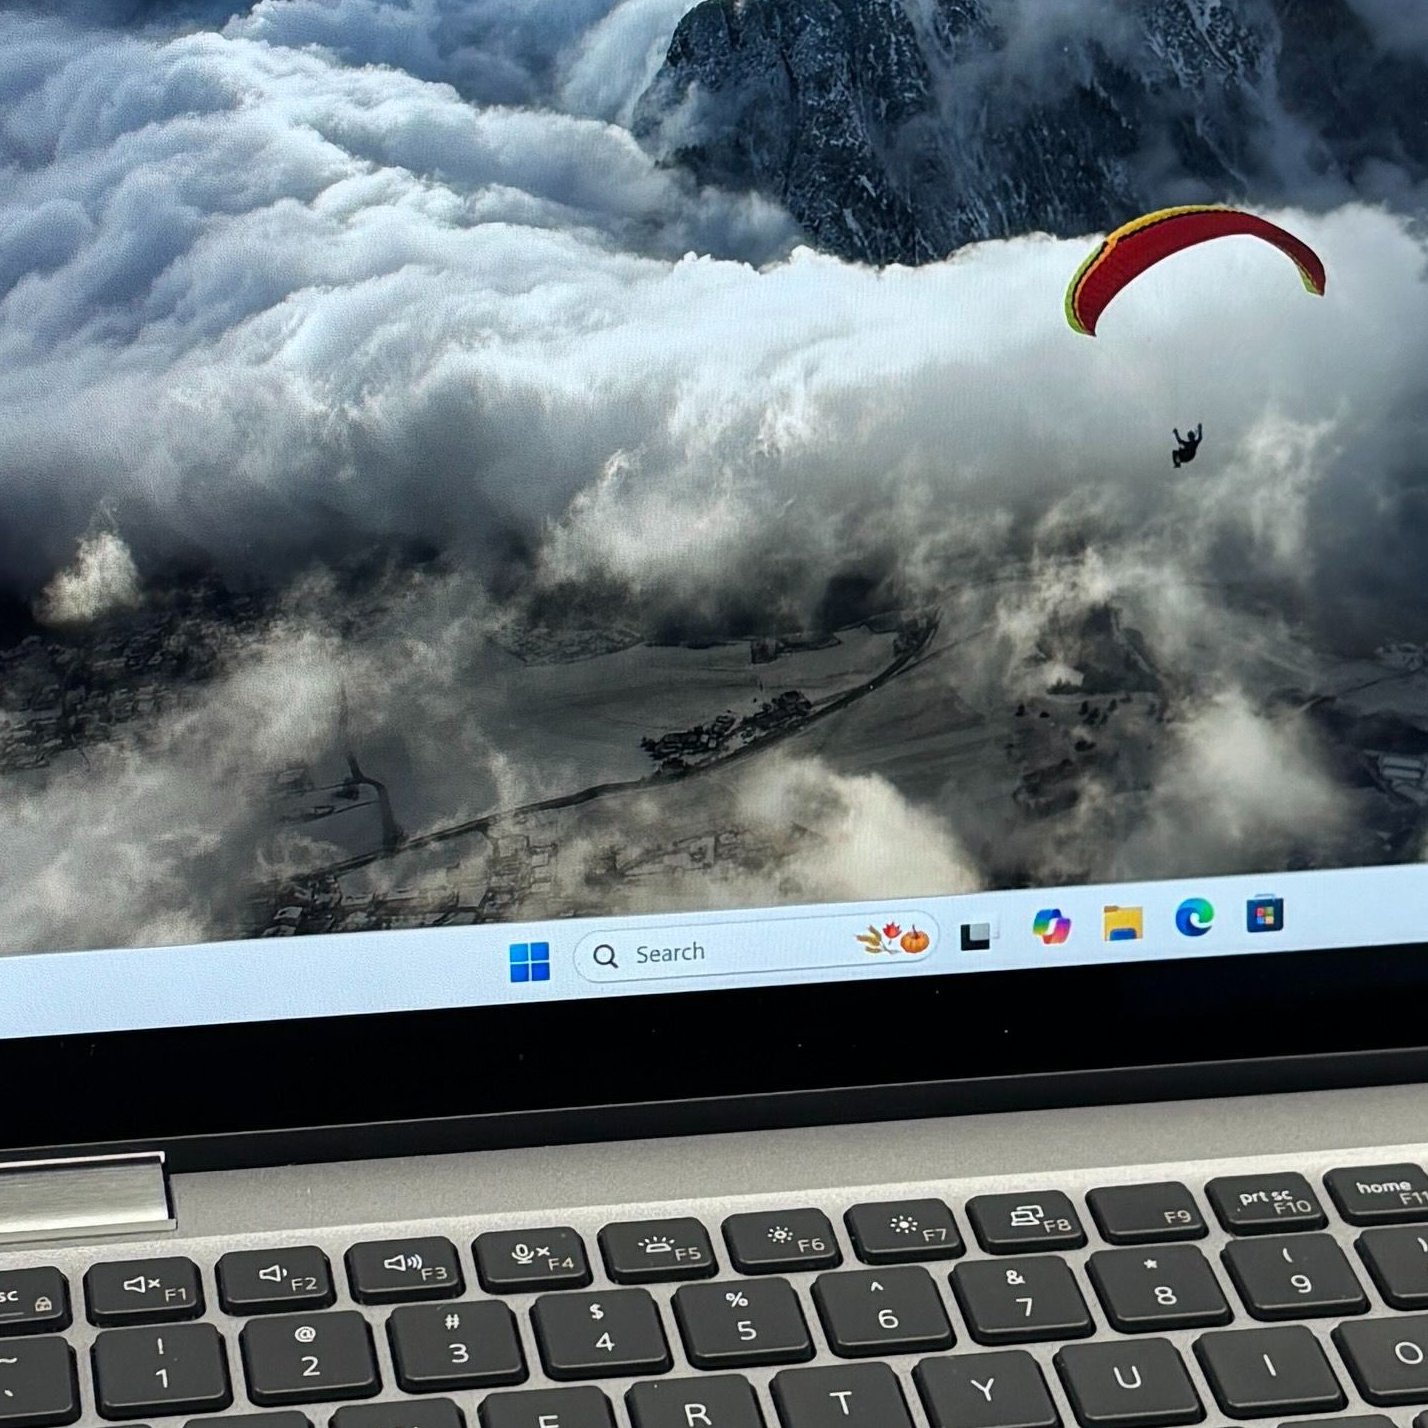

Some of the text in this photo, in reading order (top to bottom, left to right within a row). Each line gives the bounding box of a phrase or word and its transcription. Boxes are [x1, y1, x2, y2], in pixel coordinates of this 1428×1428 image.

[637, 942, 704, 963] Search
[1240, 1191, 1292, 1205] prt sc
[1356, 1182, 1411, 1193] home
[1395, 1342, 1423, 1364] O
[1114, 1366, 1141, 1388] U
[971, 1379, 994, 1401] Y
[830, 1391, 852, 1414] T
[685, 1404, 711, 1427] R
